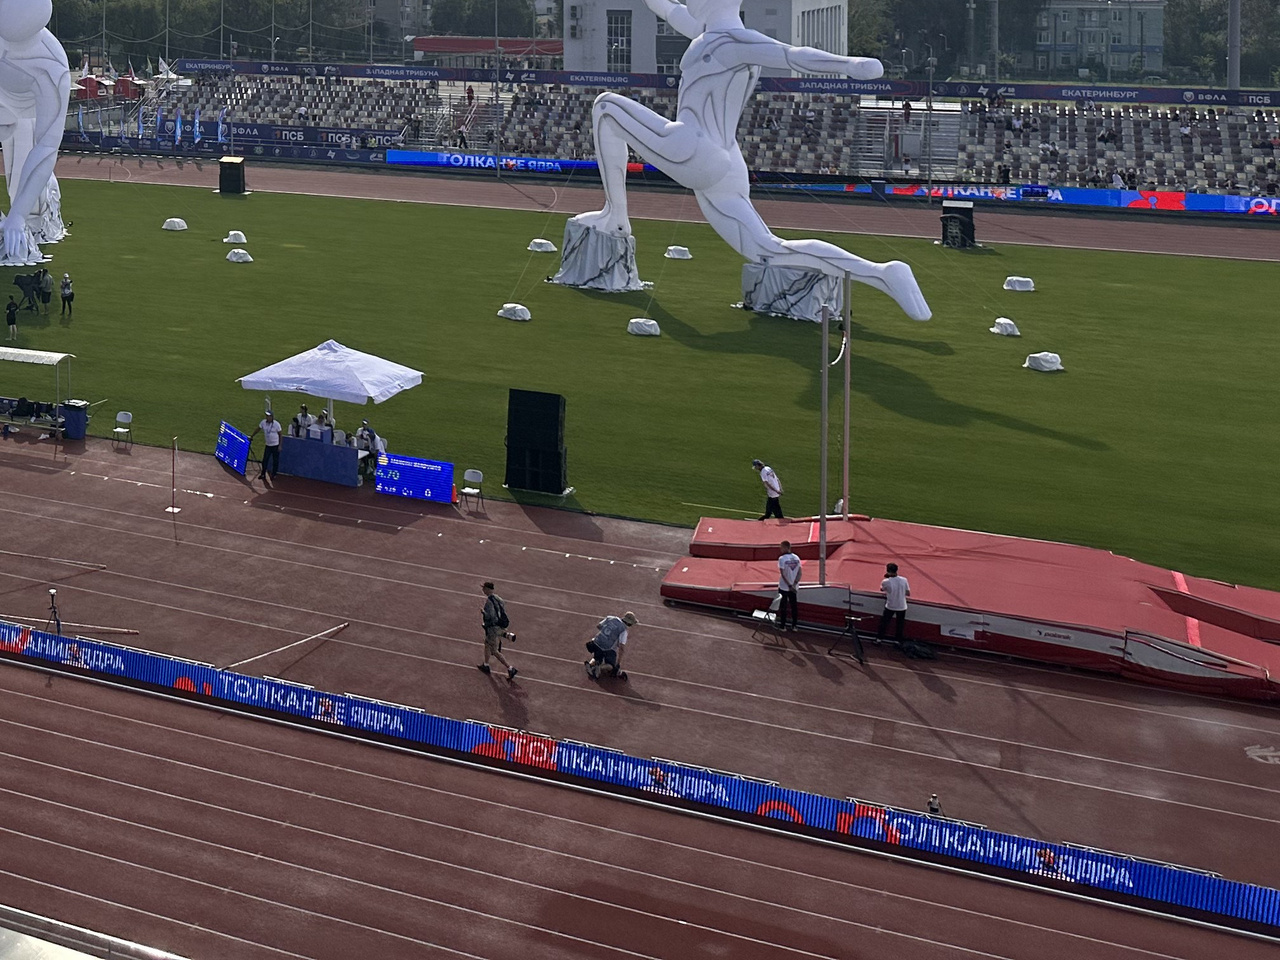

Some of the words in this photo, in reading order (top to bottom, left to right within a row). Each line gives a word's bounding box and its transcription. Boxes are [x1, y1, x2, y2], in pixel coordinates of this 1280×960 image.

[570, 75, 629, 83] EKATERINBURG
[799, 82, 849, 90] ЗАПАДНАЯ
[849, 82, 892, 91] ТРИБУНА
[1062, 89, 1139, 99] ЕКАТЕРИНБУРГ
[1198, 94, 1227, 102] ВФЛА
[1248, 95, 1271, 104] ПСБ
[282, 131, 304, 141] ПСБ
[351, 706, 404, 733] ЯДРА
